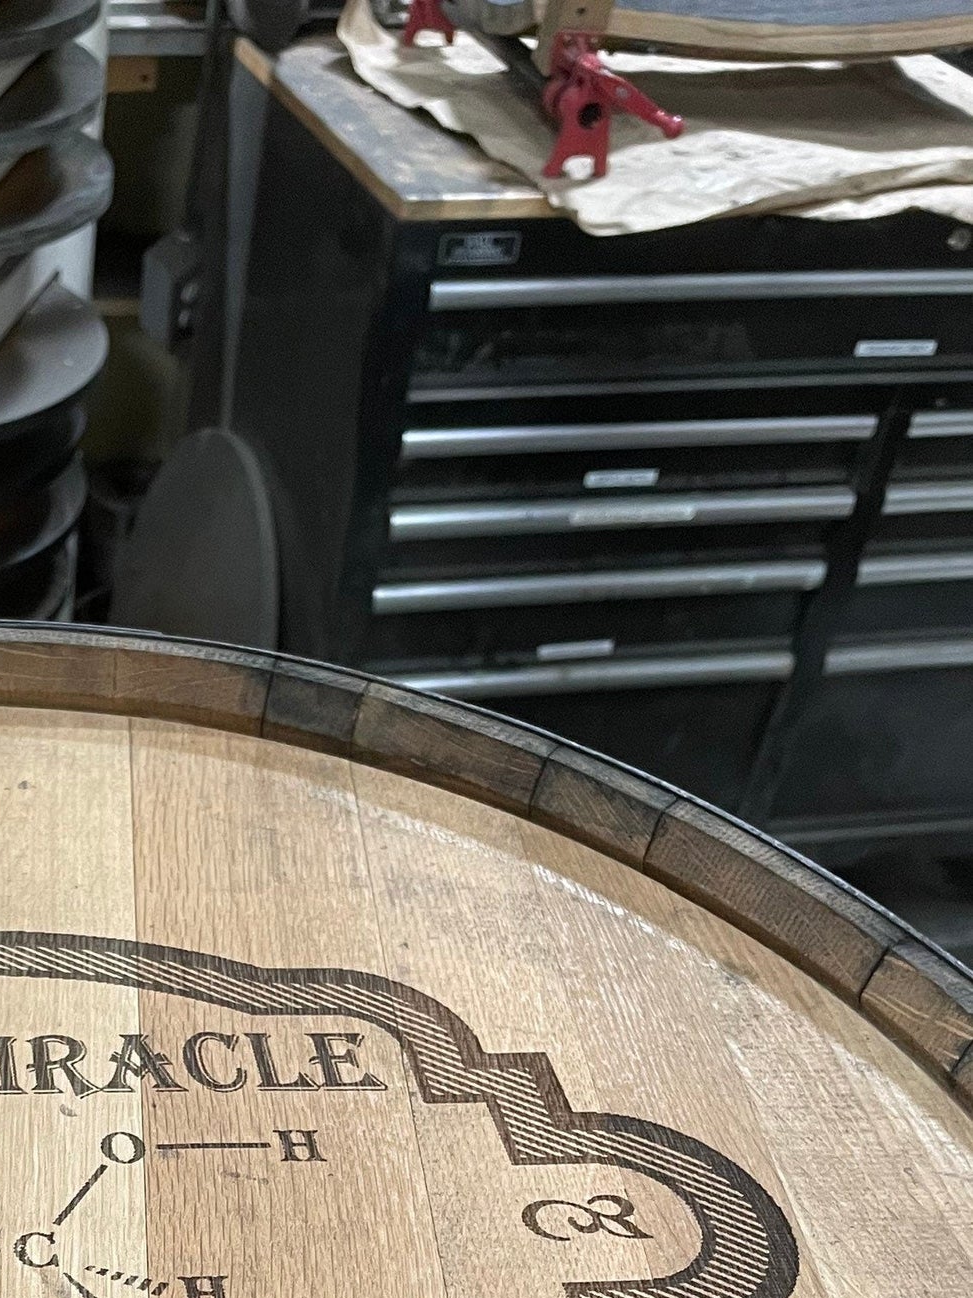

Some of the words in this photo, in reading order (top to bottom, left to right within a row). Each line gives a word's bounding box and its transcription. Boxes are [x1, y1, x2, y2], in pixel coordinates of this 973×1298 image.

[100, 1131, 146, 1164] O
[273, 1129, 327, 1162] H
[13, 1231, 59, 1268] C
